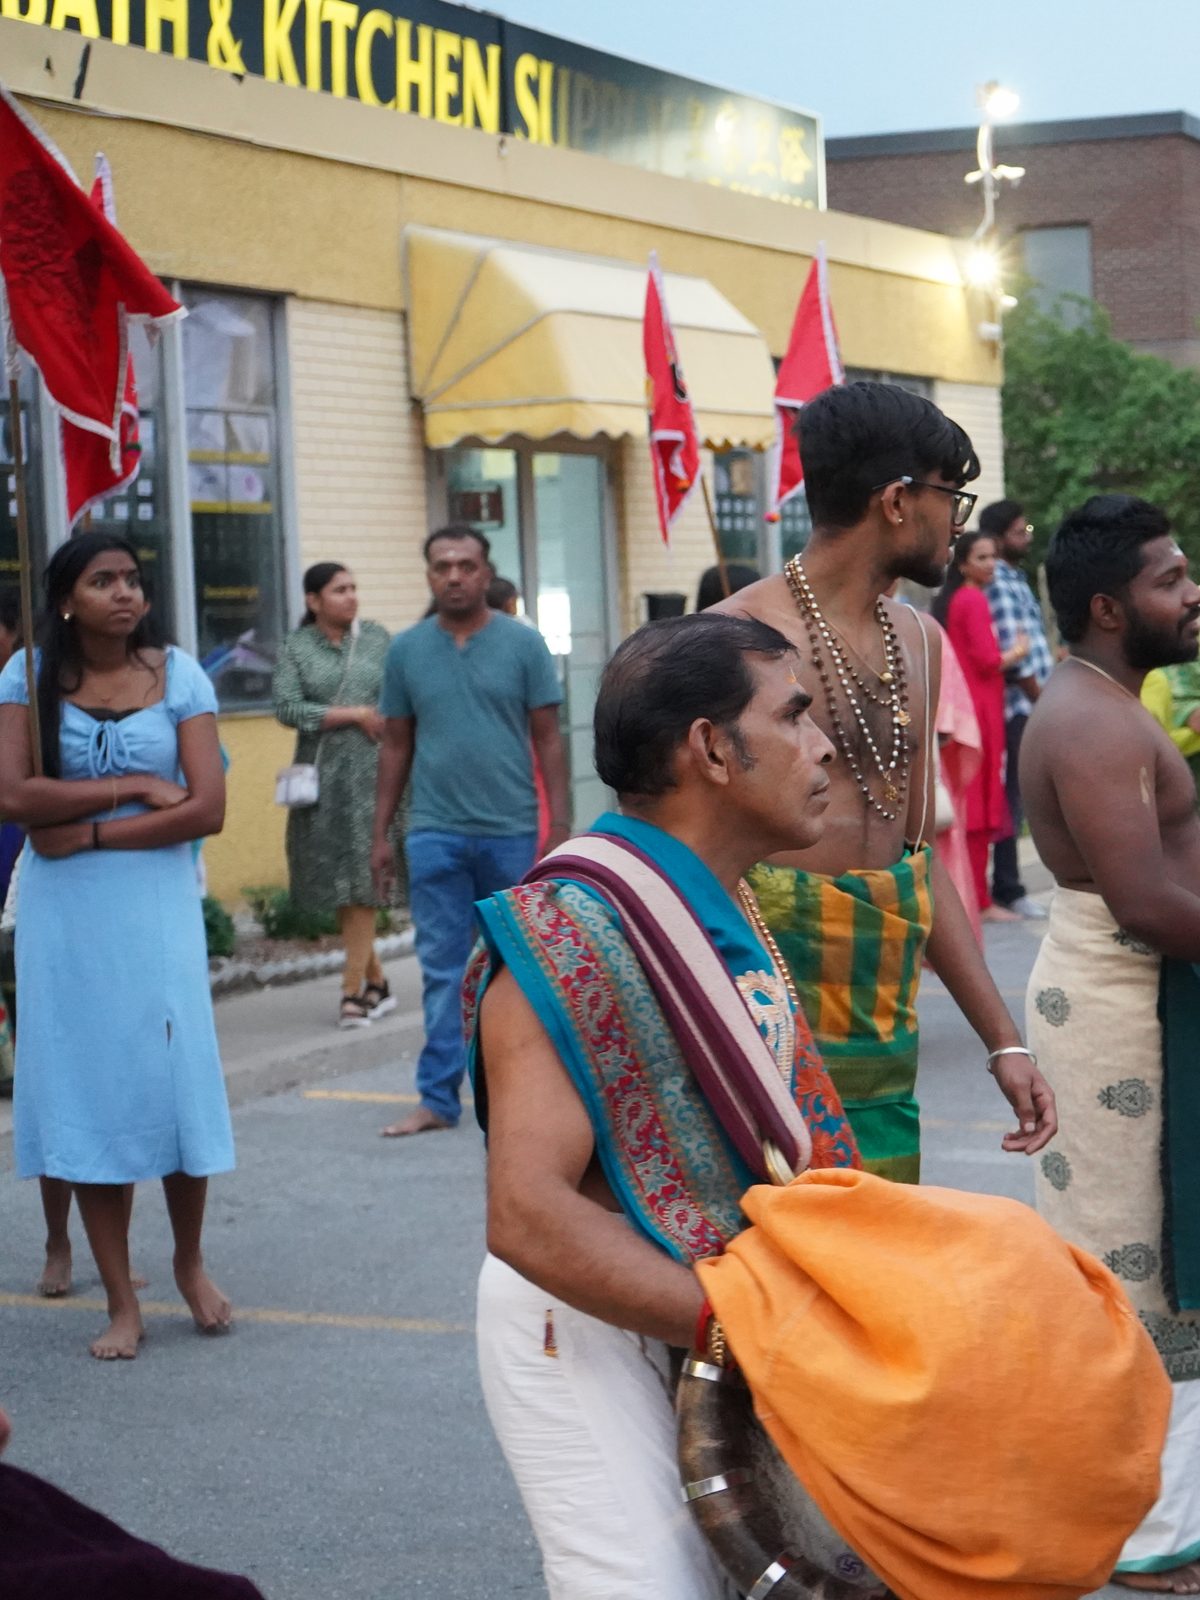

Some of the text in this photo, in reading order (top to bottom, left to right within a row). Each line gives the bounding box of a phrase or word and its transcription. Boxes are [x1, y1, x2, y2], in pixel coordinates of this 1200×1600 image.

[207, 0, 247, 74] &
[264, 0, 501, 135] KITCHEN
[513, 52, 677, 168] SUPP
